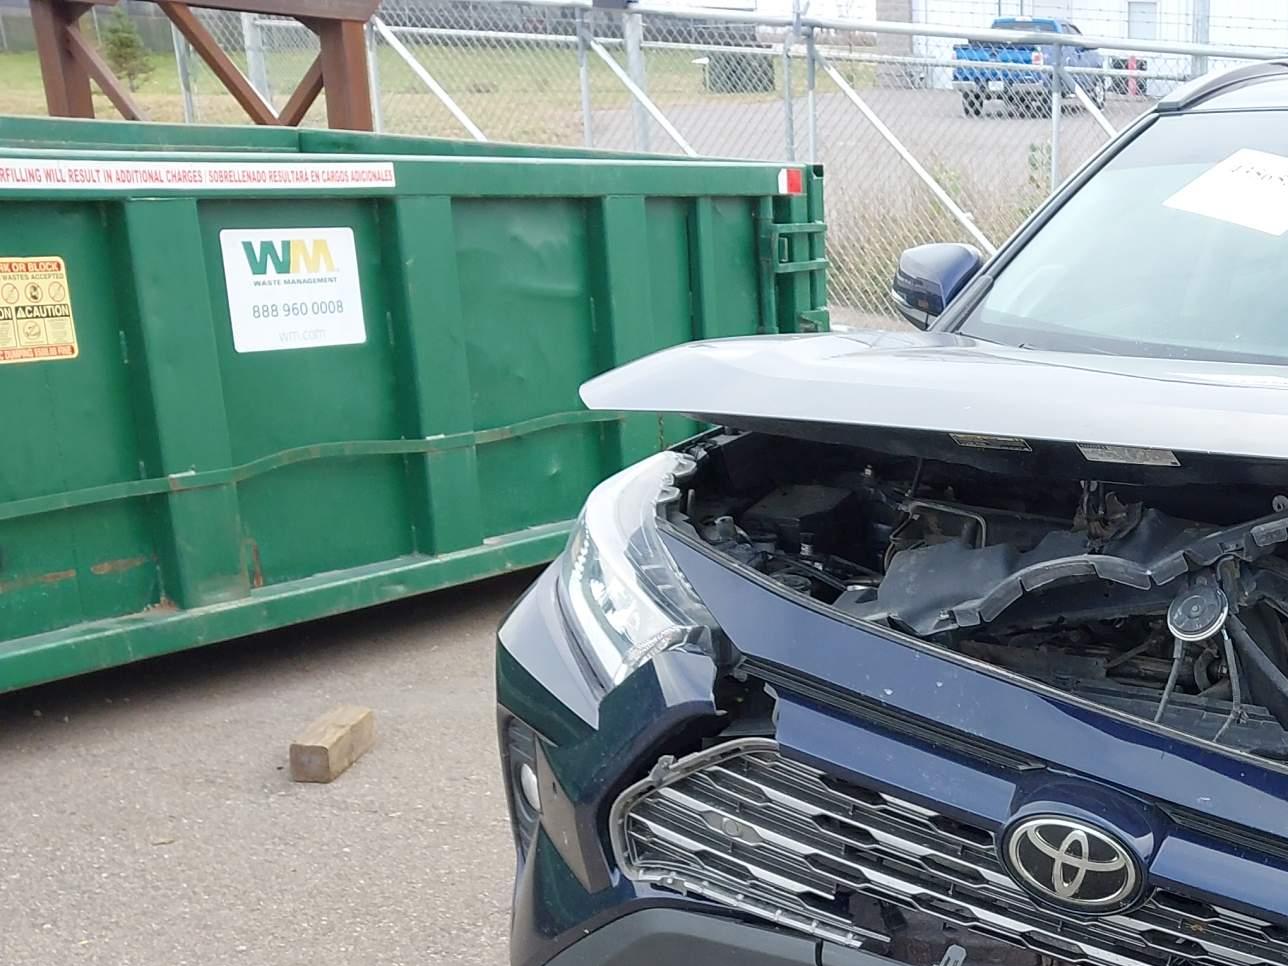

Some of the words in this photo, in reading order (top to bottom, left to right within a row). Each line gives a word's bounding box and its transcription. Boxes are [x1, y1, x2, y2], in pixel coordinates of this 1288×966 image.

[44, 167, 66, 183] WILL
[68, 168, 100, 183] RESULT
[104, 168, 113, 183] IN
[115, 169, 164, 183] ADDITIONAL
[165, 169, 203, 183] CHARGES
[311, 170, 320, 182] EN
[321, 170, 349, 182] CARGOS
[241, 239, 336, 275] WM
[11, 262, 26, 272] OR
[28, 261, 59, 272] BLOCK
[283, 277, 337, 285] MANAGEMENT
[25, 304, 69, 318] CAUTION
[252, 304, 279, 319] 888
[282, 302, 309, 317] 960
[311, 300, 344, 315] 0008
